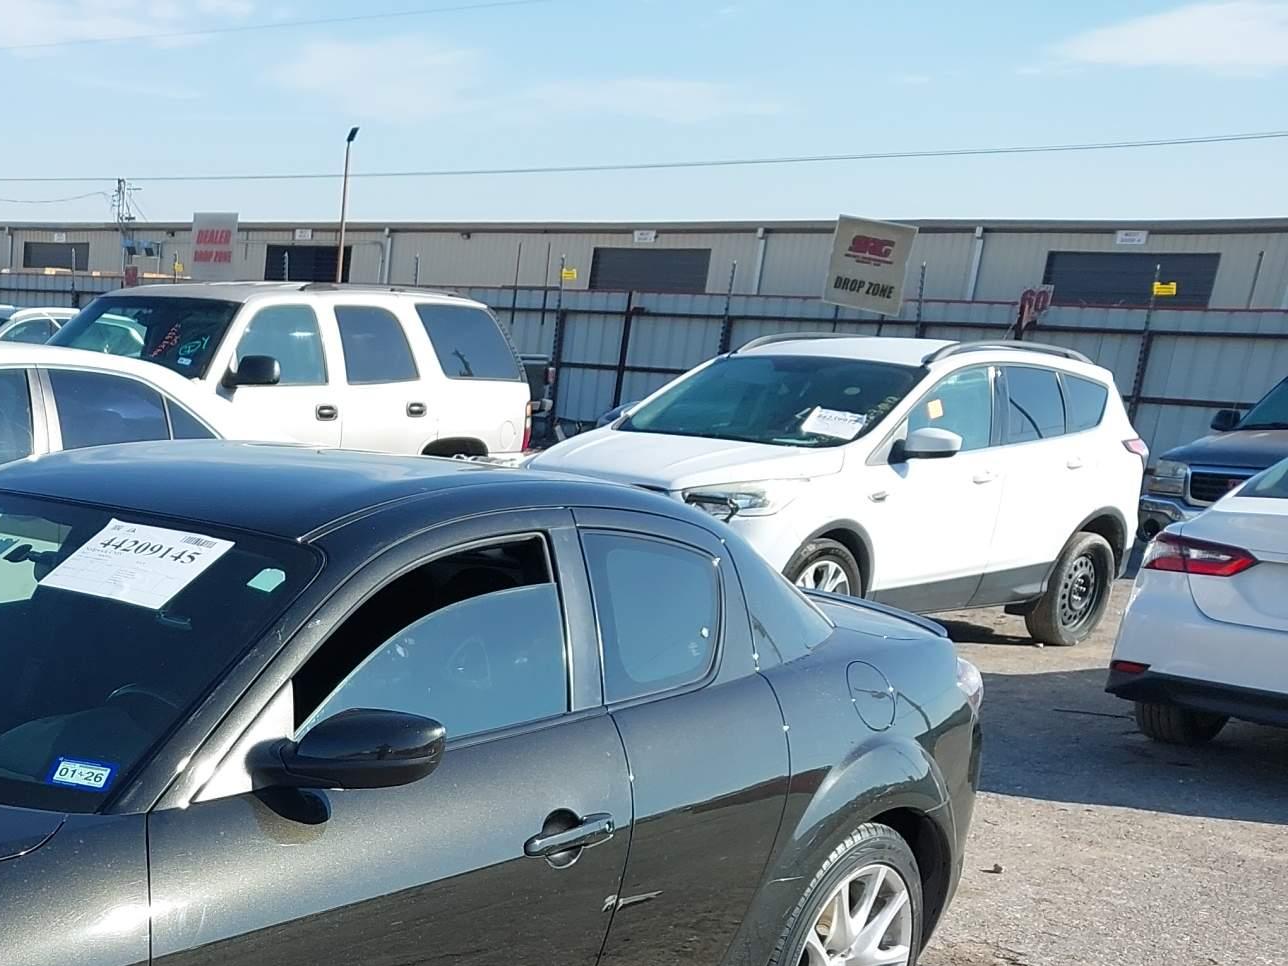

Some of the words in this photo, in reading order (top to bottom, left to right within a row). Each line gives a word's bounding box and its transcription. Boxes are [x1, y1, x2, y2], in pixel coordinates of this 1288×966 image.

[196, 229, 232, 245] DEALER
[833, 276, 866, 294] DROP
[865, 281, 895, 299] ZONE
[100, 536, 203, 564] 44209145
